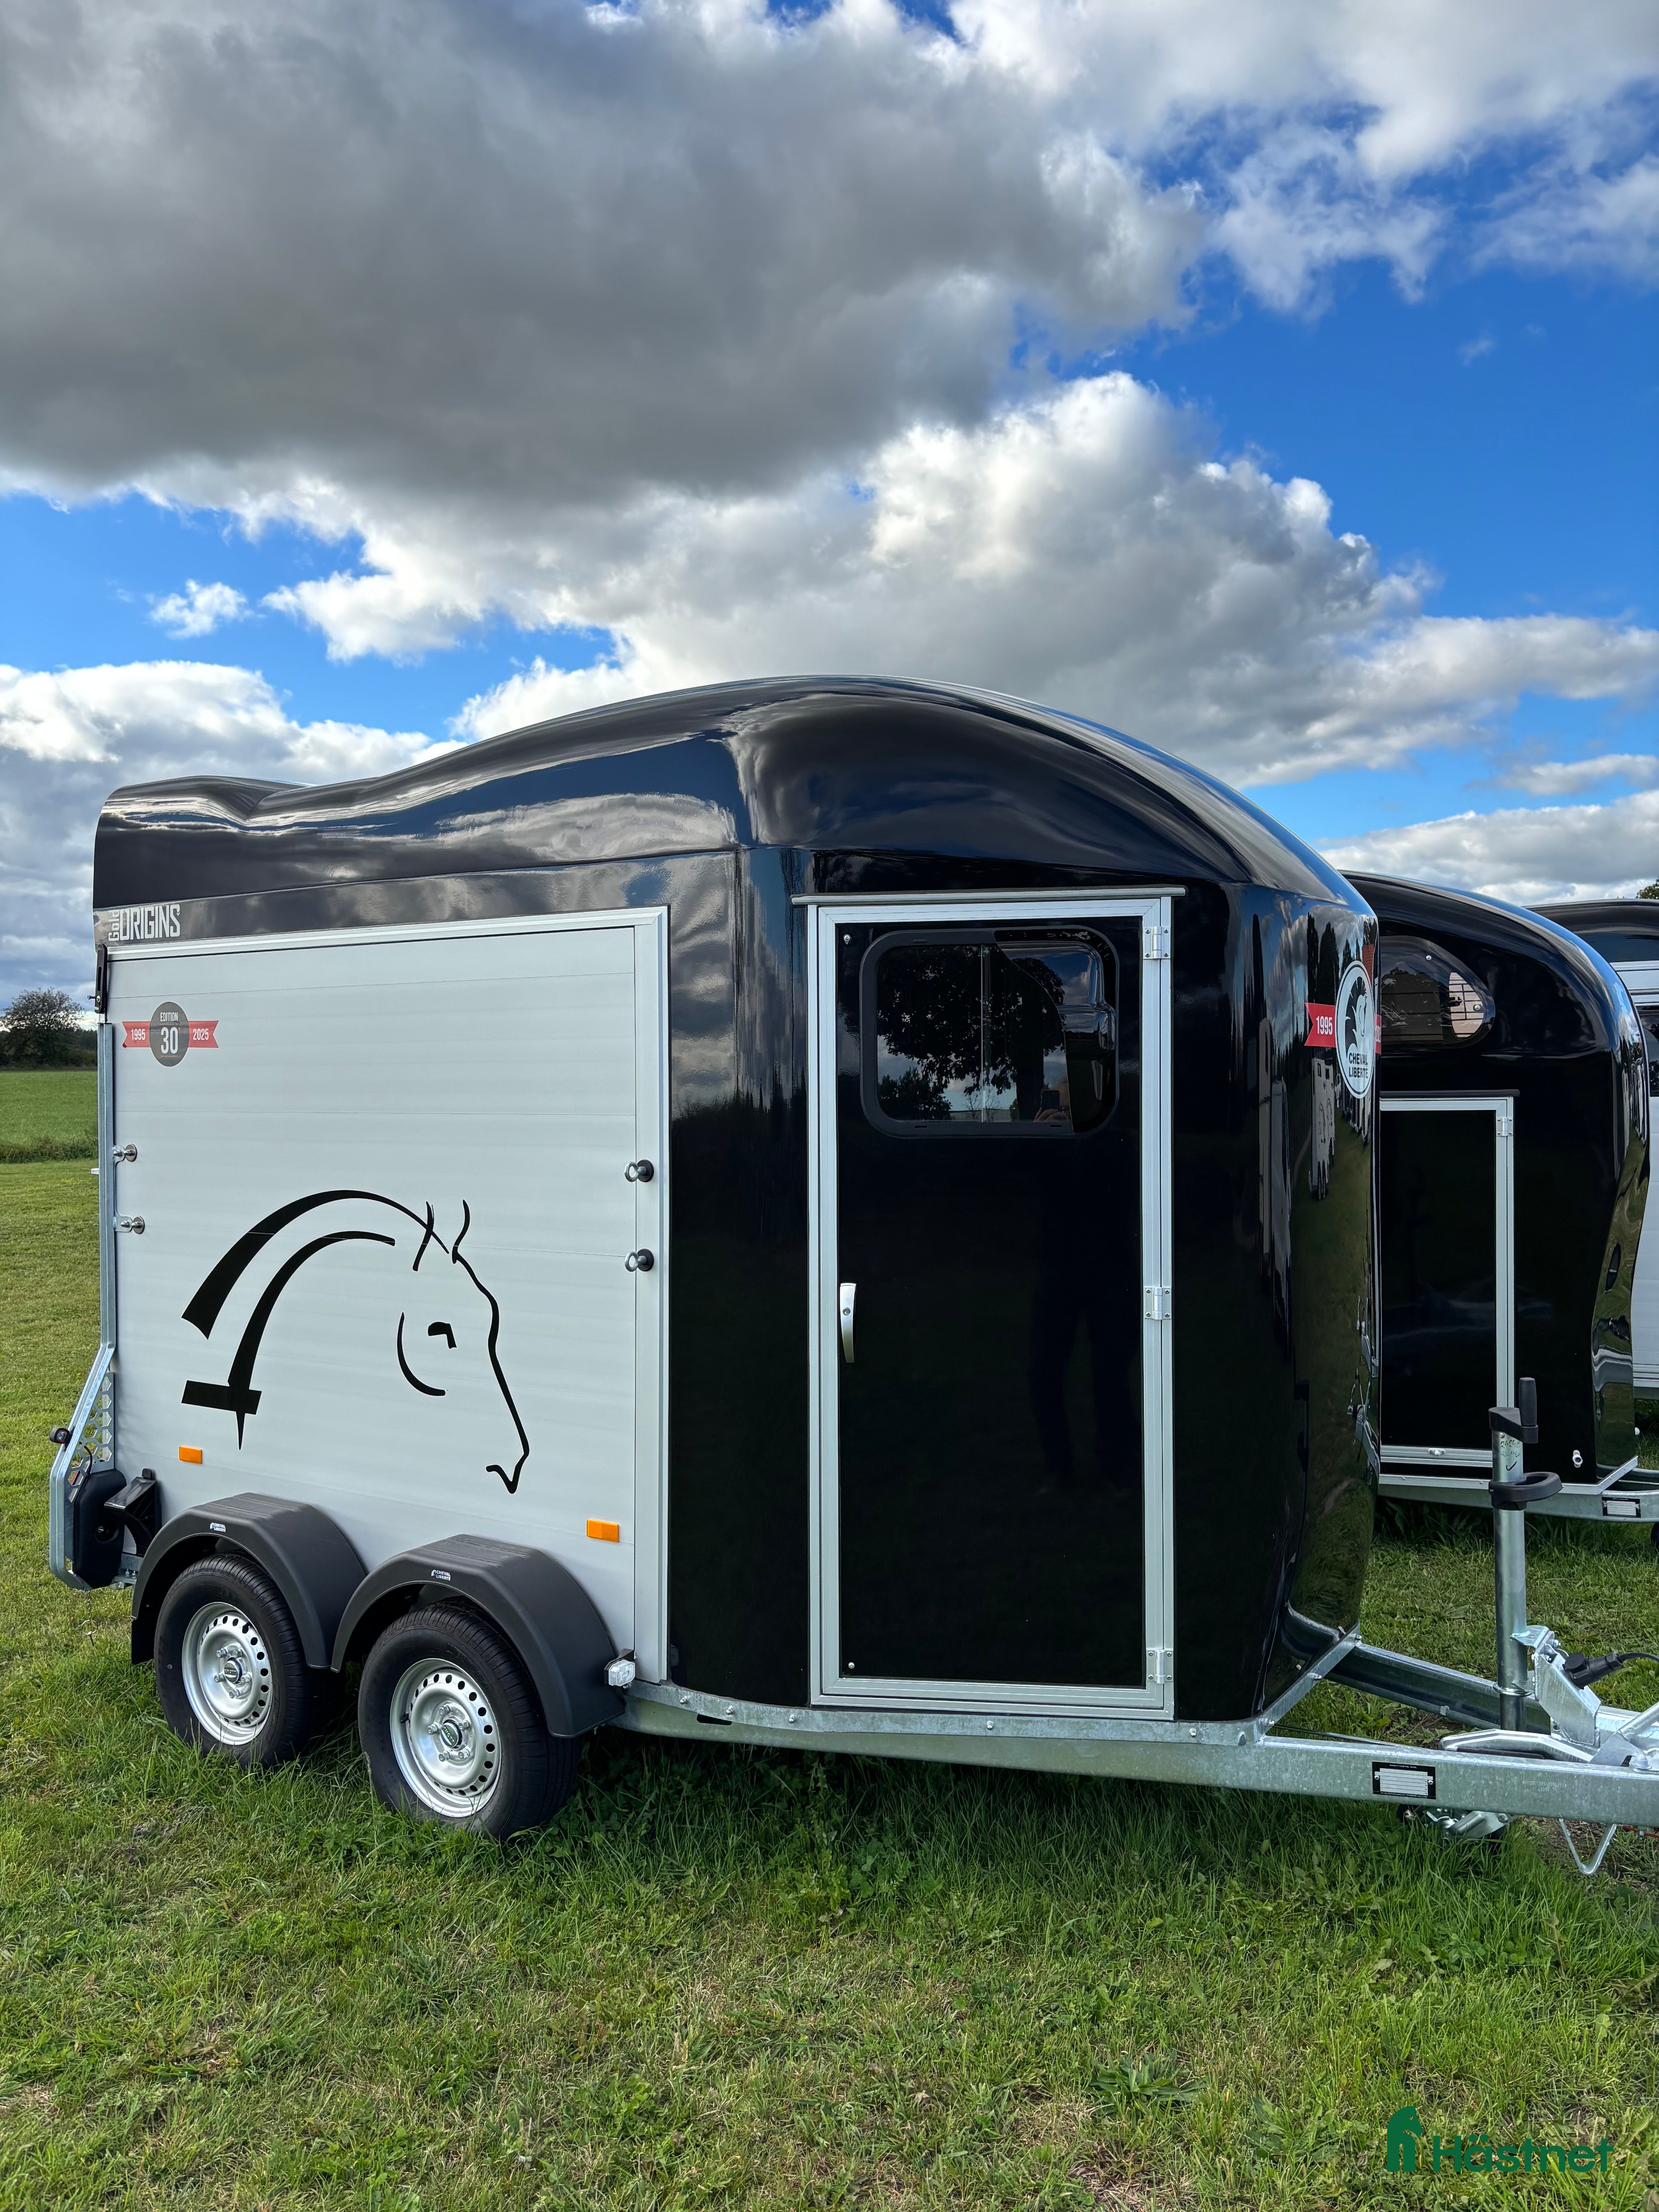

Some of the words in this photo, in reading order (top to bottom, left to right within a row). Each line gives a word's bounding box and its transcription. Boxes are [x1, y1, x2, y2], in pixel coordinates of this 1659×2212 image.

[120, 904, 180, 941] ORIGINS
[160, 1012, 178, 1022] EDITION
[1316, 1016, 1333, 1035] 1995
[131, 1029, 146, 1041] 1995
[161, 1027, 179, 1054] 30
[193, 1029, 209, 1041] 2025
[1349, 1052, 1368, 1066] CHEVAL
[1349, 1065, 1368, 1079] LIBERTÉ
